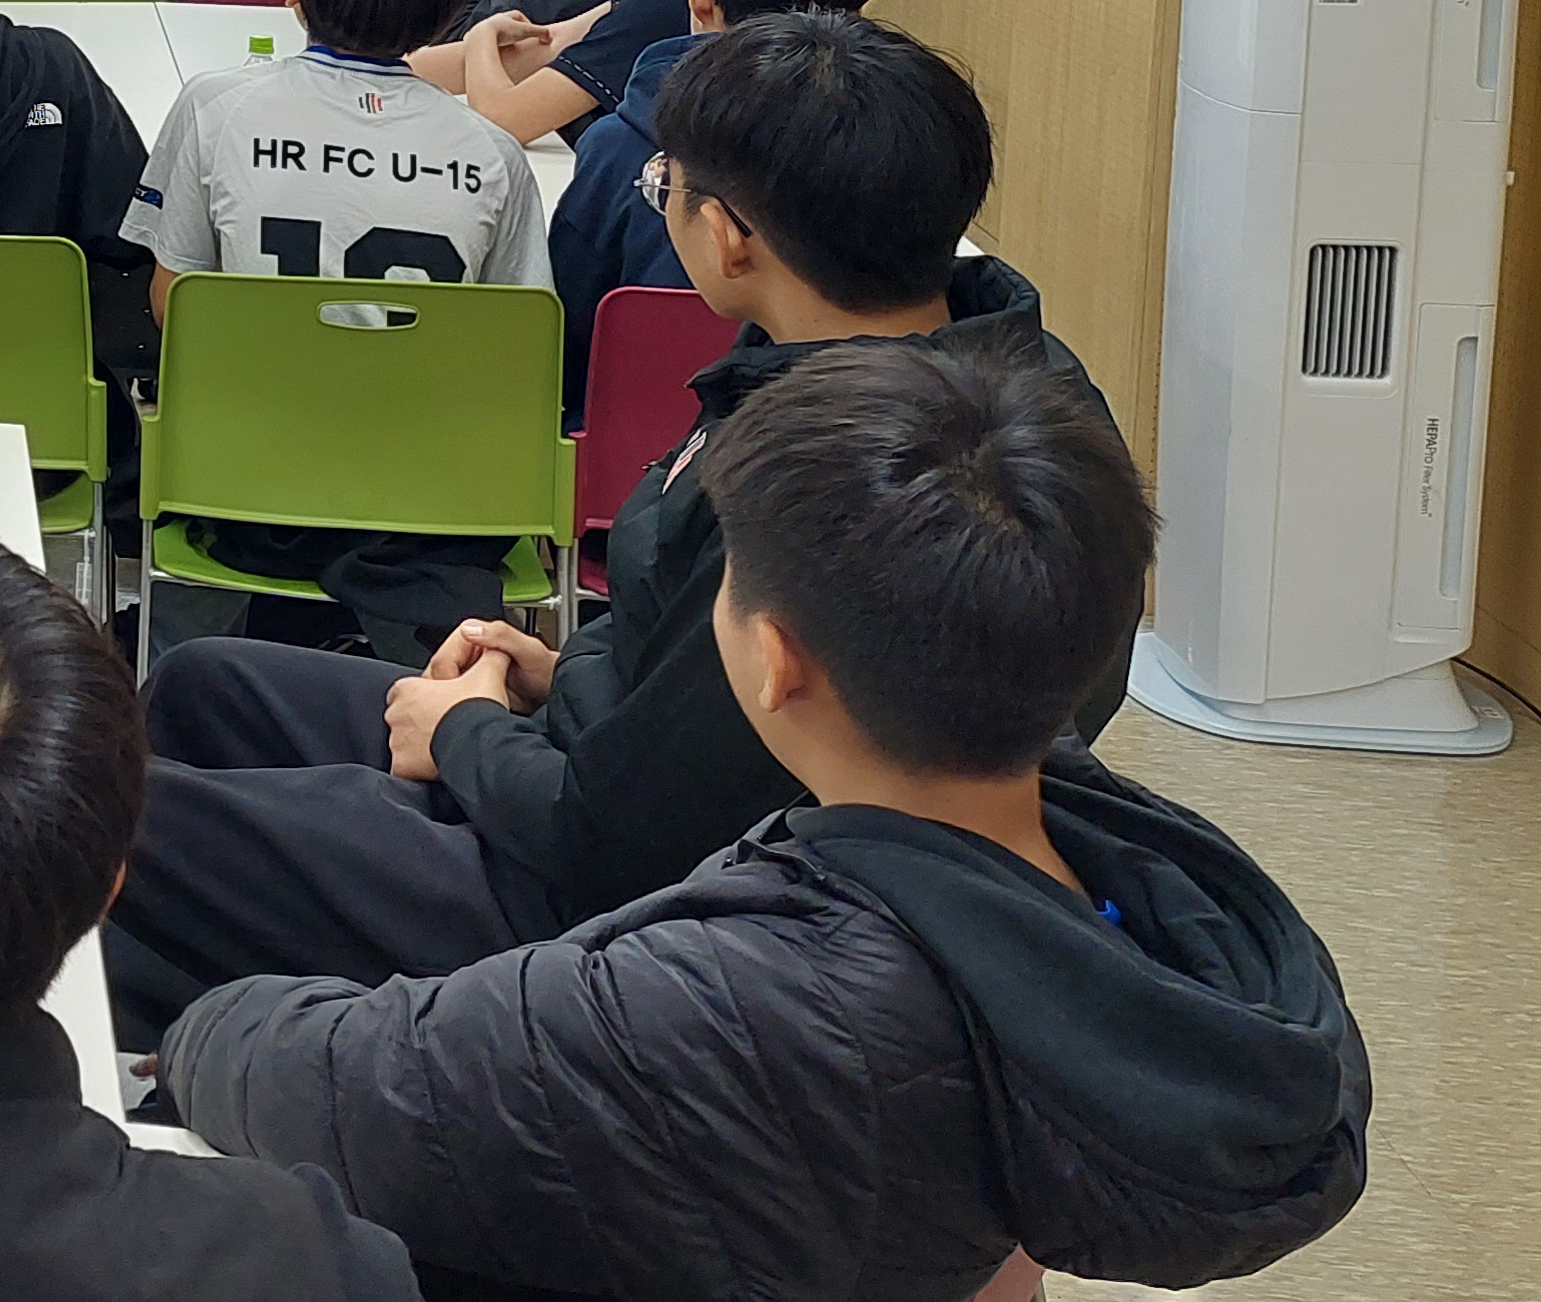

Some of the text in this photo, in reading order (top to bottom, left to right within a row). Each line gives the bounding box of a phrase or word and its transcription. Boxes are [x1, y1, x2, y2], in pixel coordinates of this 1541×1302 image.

[252, 137, 482, 194] HR FC U-15
